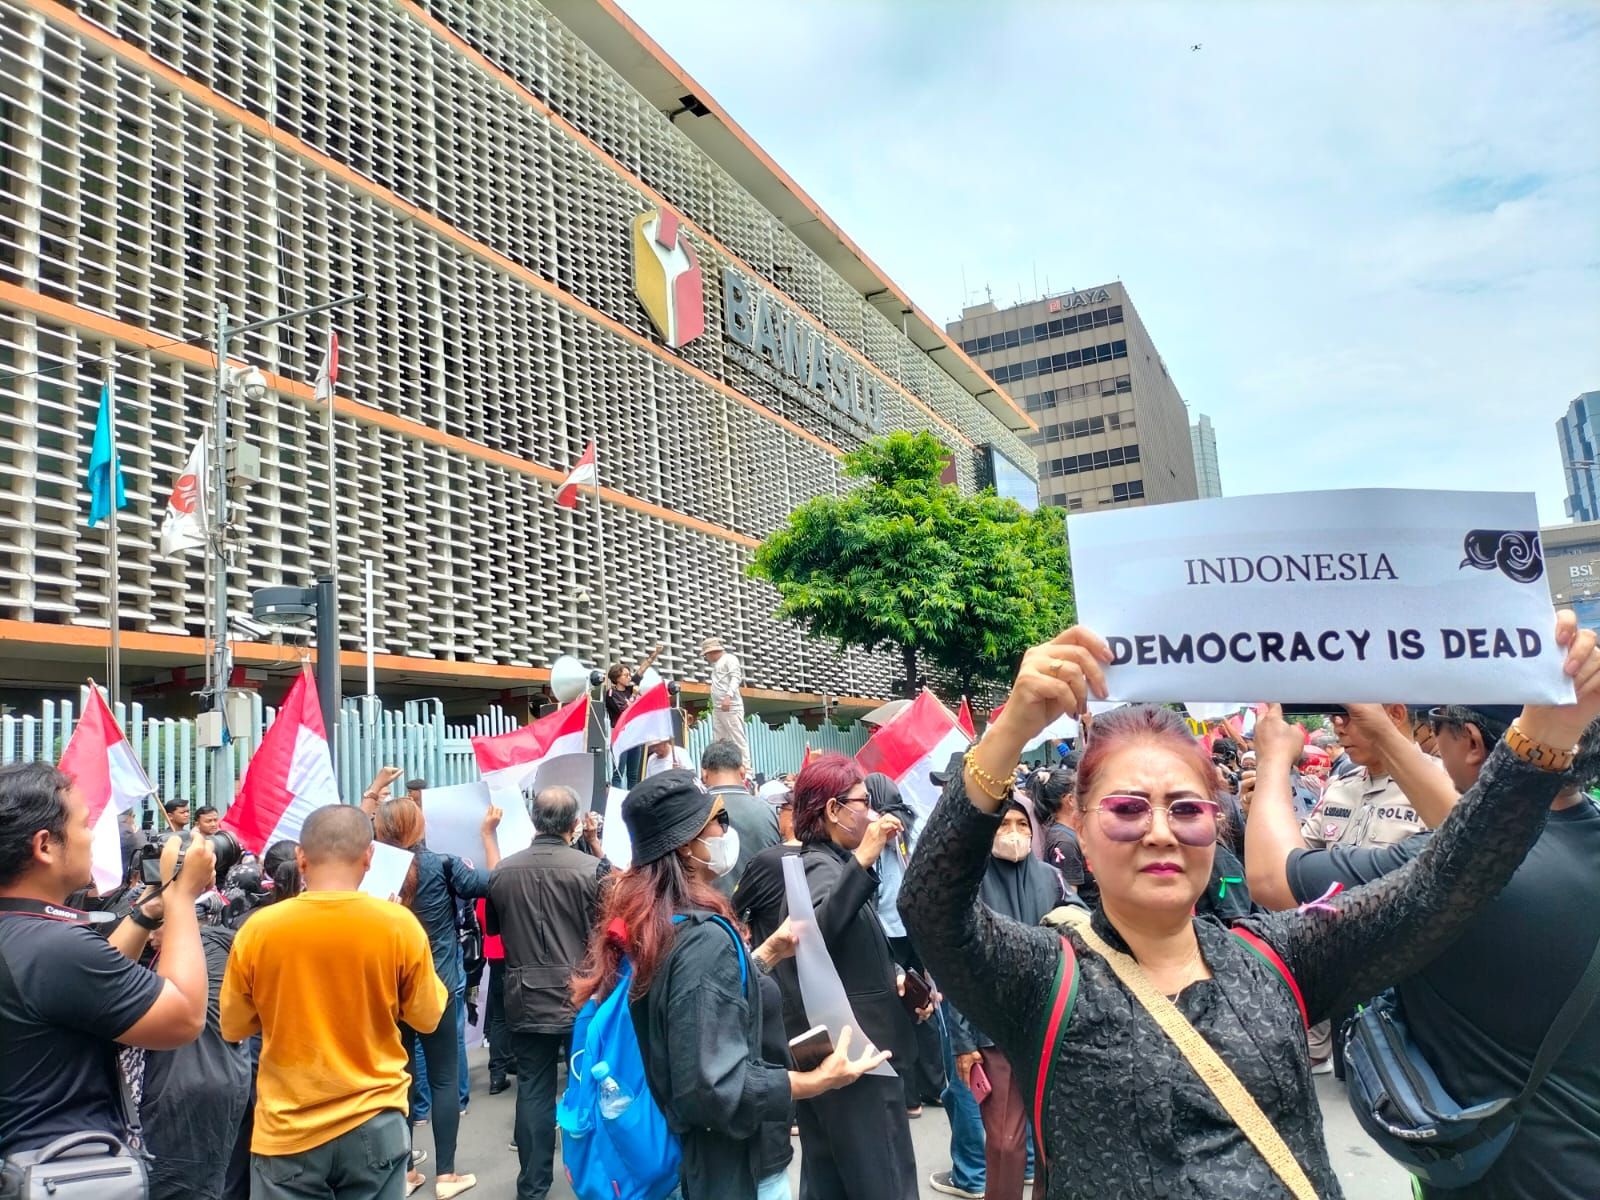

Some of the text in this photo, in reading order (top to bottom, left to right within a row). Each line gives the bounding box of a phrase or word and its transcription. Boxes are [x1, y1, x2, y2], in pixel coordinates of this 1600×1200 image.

[1063, 288, 1112, 311] JAYA
[722, 267, 882, 434] BAWASLU
[1184, 552, 1399, 585] INDONESIA
[1569, 564, 1593, 578] BSI
[1105, 627, 1542, 666] DEMOCRACY IS DEAD
[44, 905, 78, 920] Canon
